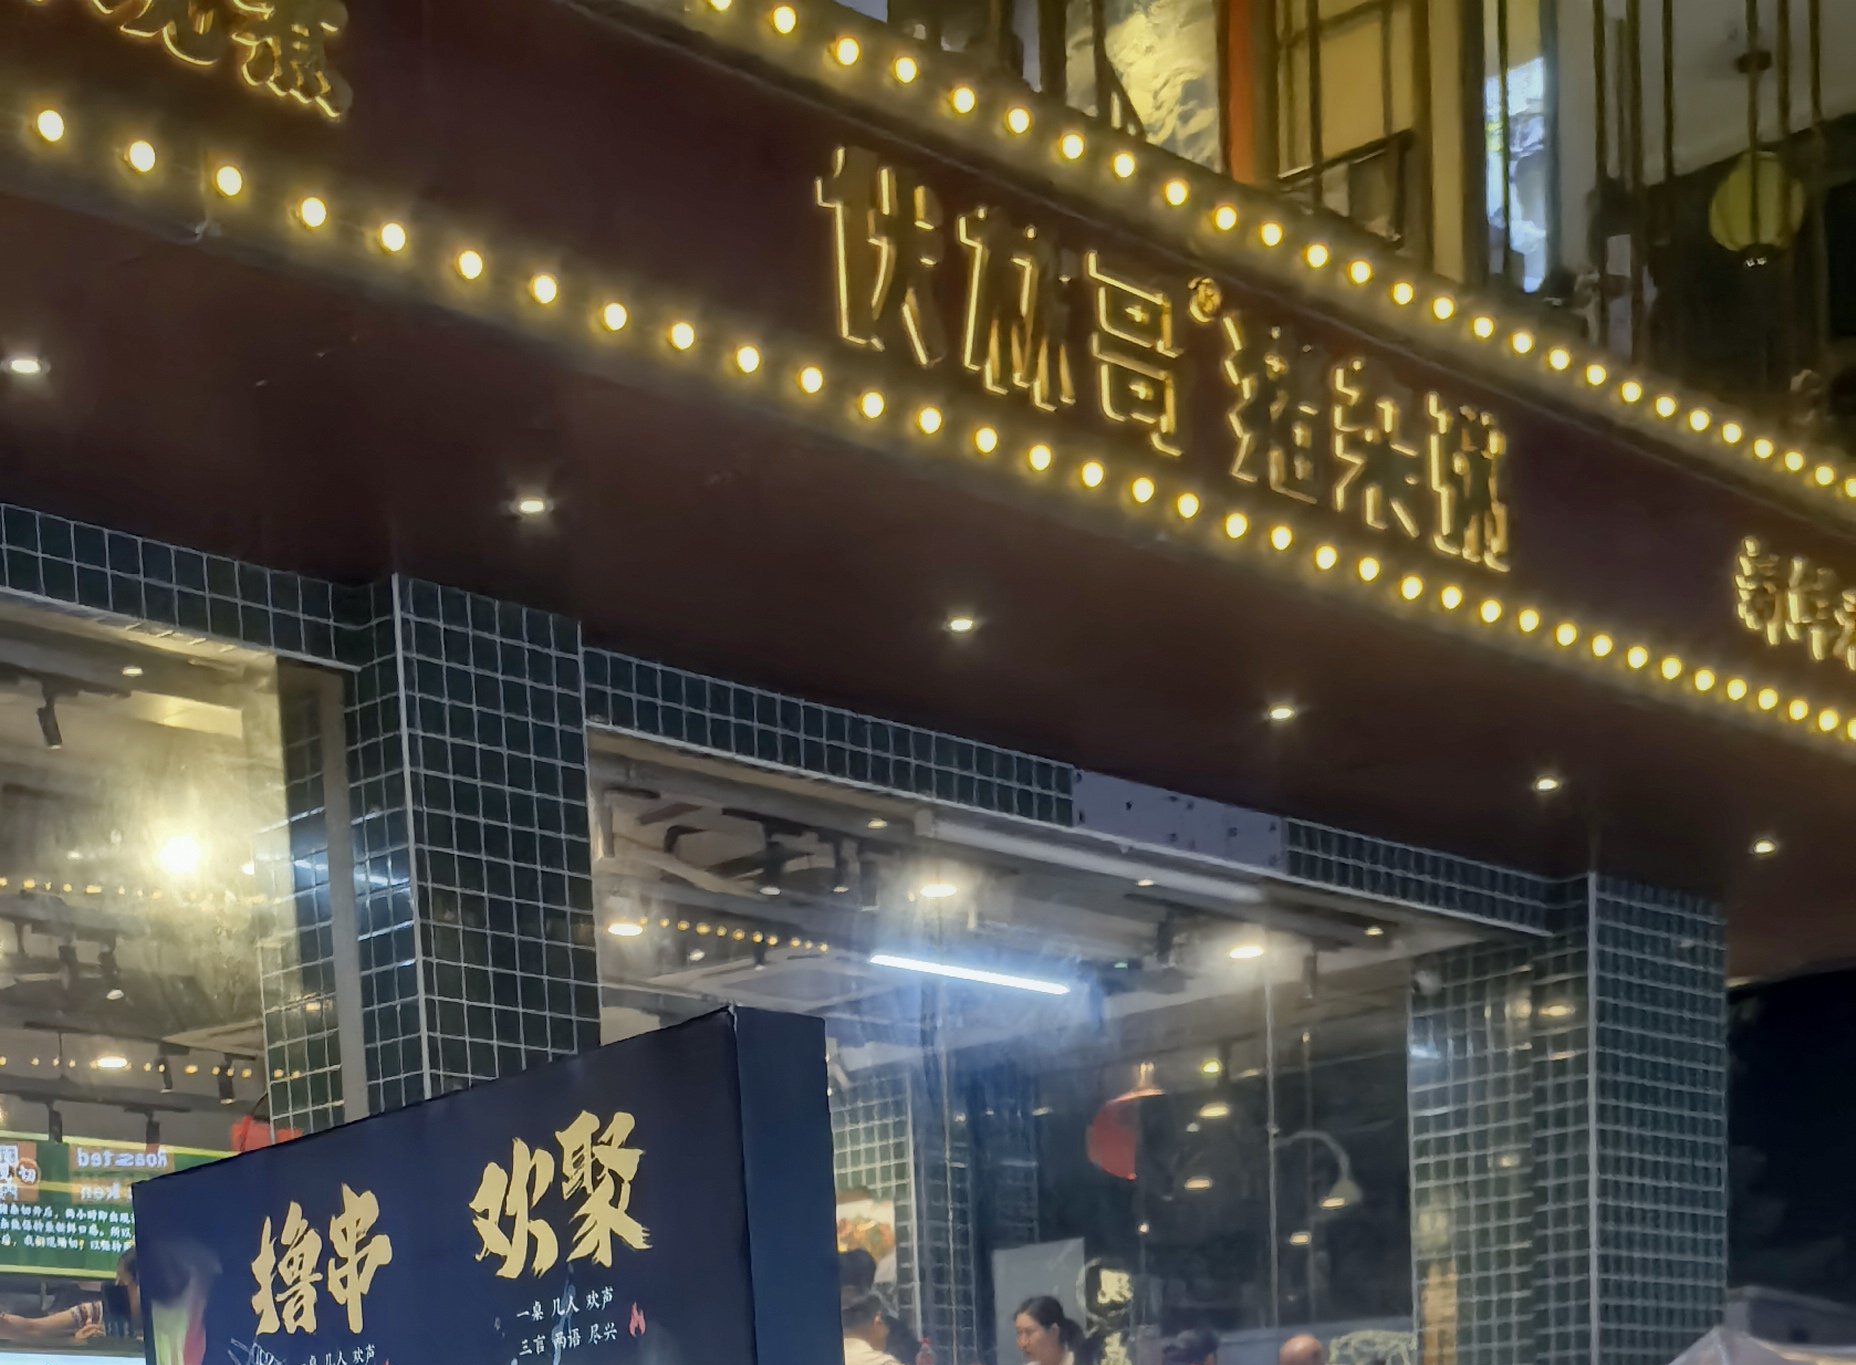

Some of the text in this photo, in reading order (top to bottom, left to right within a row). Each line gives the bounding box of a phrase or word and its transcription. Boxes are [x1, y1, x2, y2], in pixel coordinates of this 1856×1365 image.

[469, 1110, 653, 1279] 欢聚
[251, 1183, 393, 1334] 撸串
[515, 1286, 614, 1322] 一桌 几人 欢声
[352, 1343, 376, 1365] 欢声
[552, 1327, 582, 1351] 两语
[588, 1322, 618, 1346] 尽兴
